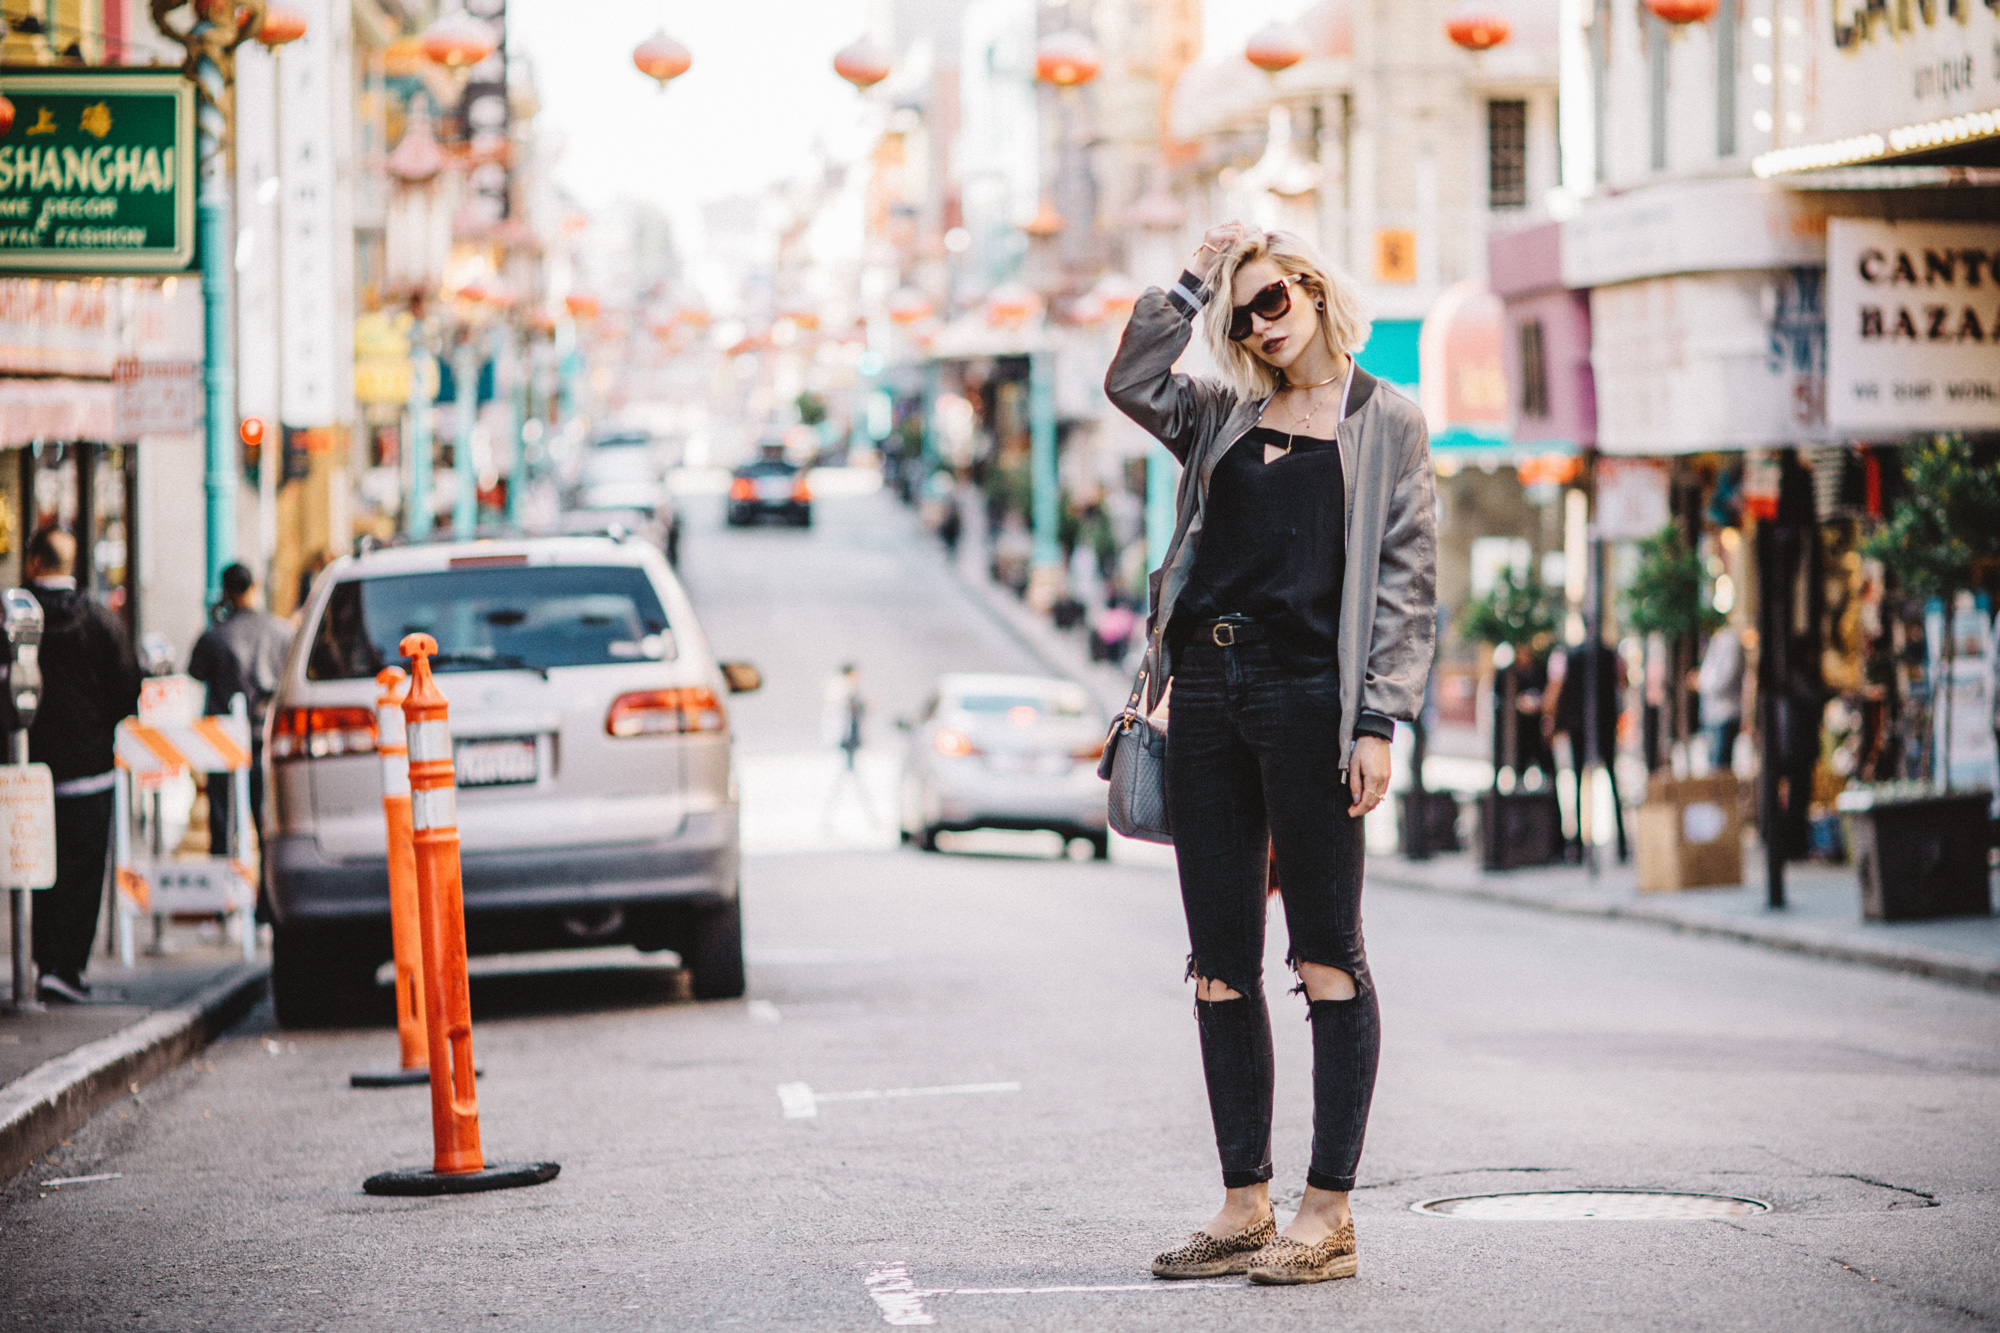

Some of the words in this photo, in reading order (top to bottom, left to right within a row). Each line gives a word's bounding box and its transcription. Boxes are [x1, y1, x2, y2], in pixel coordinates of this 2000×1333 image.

[0, 145, 174, 194] SHANGHAI
[37, 196, 117, 228] DECOR
[55, 226, 147, 247] FASHION
